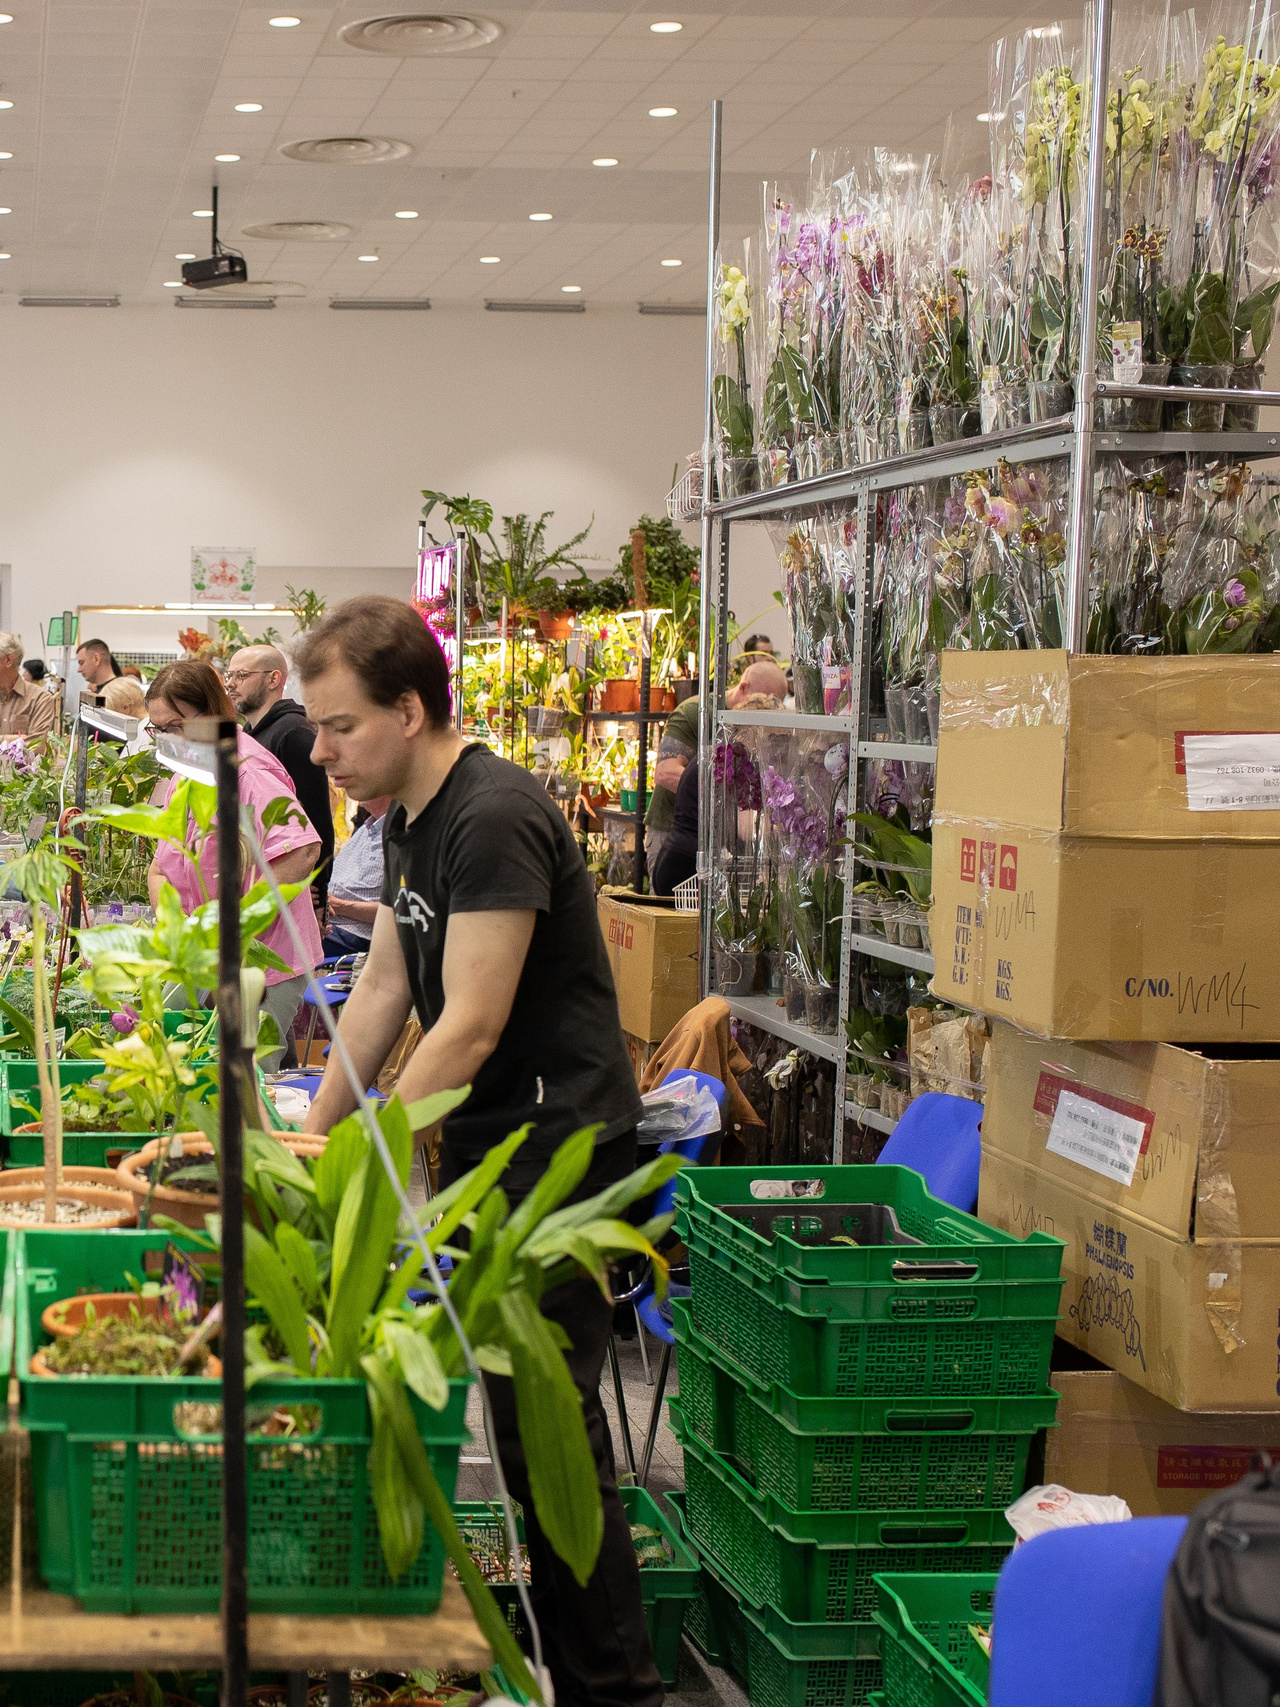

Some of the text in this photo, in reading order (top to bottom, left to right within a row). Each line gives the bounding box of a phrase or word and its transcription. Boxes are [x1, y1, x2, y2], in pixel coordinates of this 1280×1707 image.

[956, 904, 972, 926] ITEM
[997, 958, 1014, 980] KGS.
[995, 979, 1012, 1001] KGS.
[1125, 977, 1174, 998] C/NO.
[1085, 1242, 1135, 1281] PHALAENOPSIS
[1162, 1472, 1201, 1481] STORAGE
